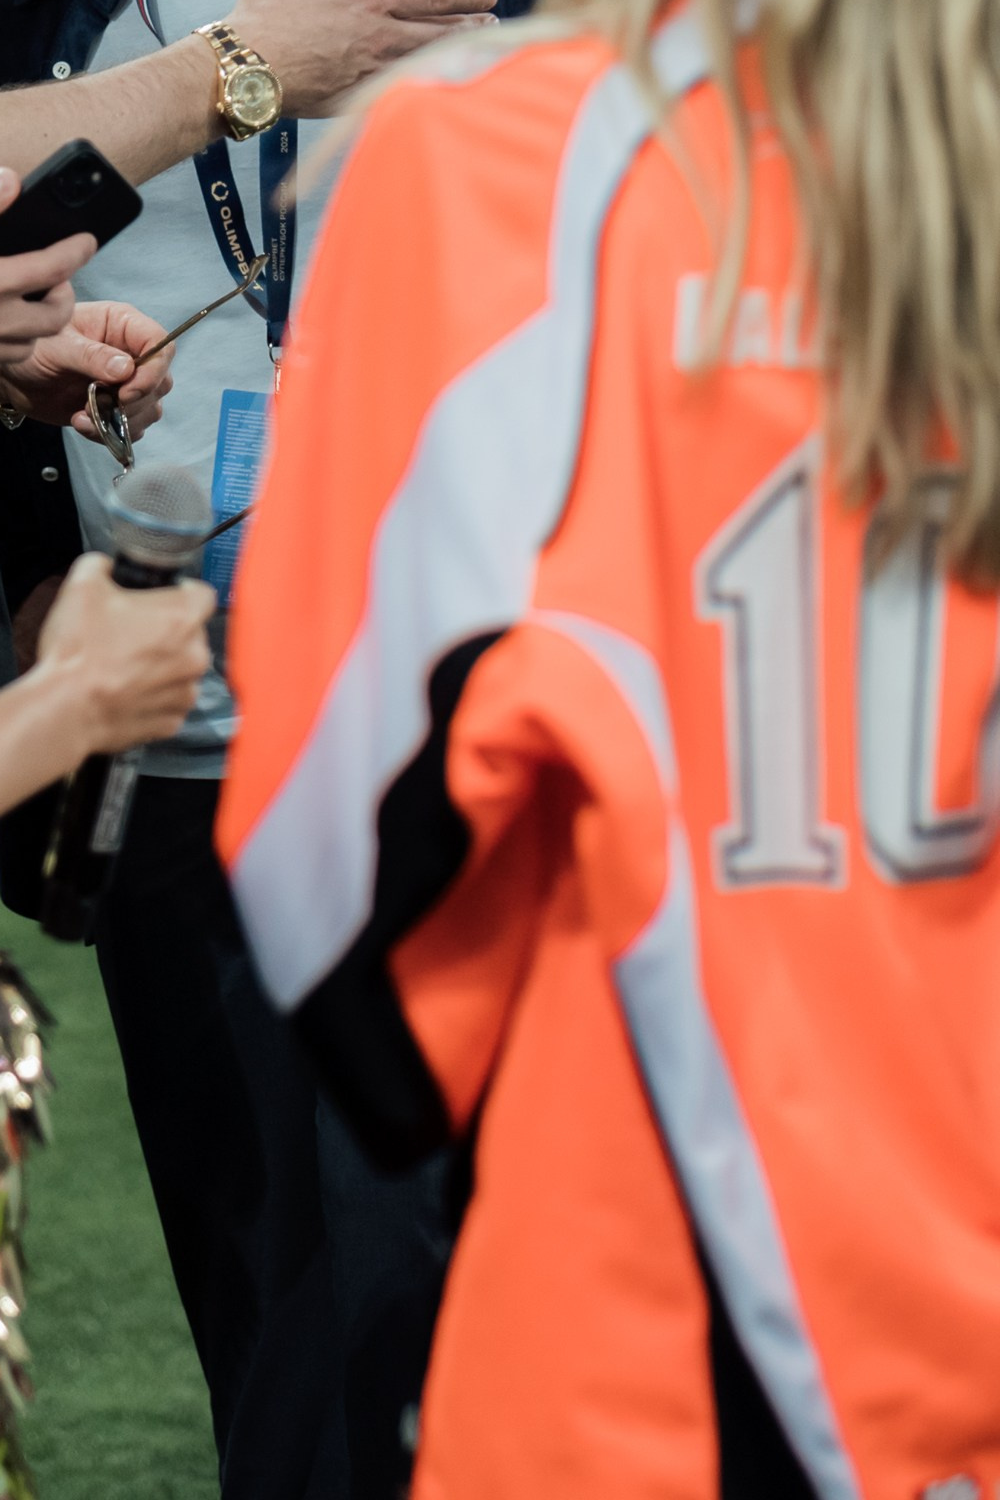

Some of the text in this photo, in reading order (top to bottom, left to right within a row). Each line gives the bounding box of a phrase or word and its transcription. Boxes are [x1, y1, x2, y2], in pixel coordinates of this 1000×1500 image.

[280, 131, 288, 153] 2024
[220, 206, 264, 291] OLIMPBT
[279, 222, 287, 281] СУПЕРКУБОК
